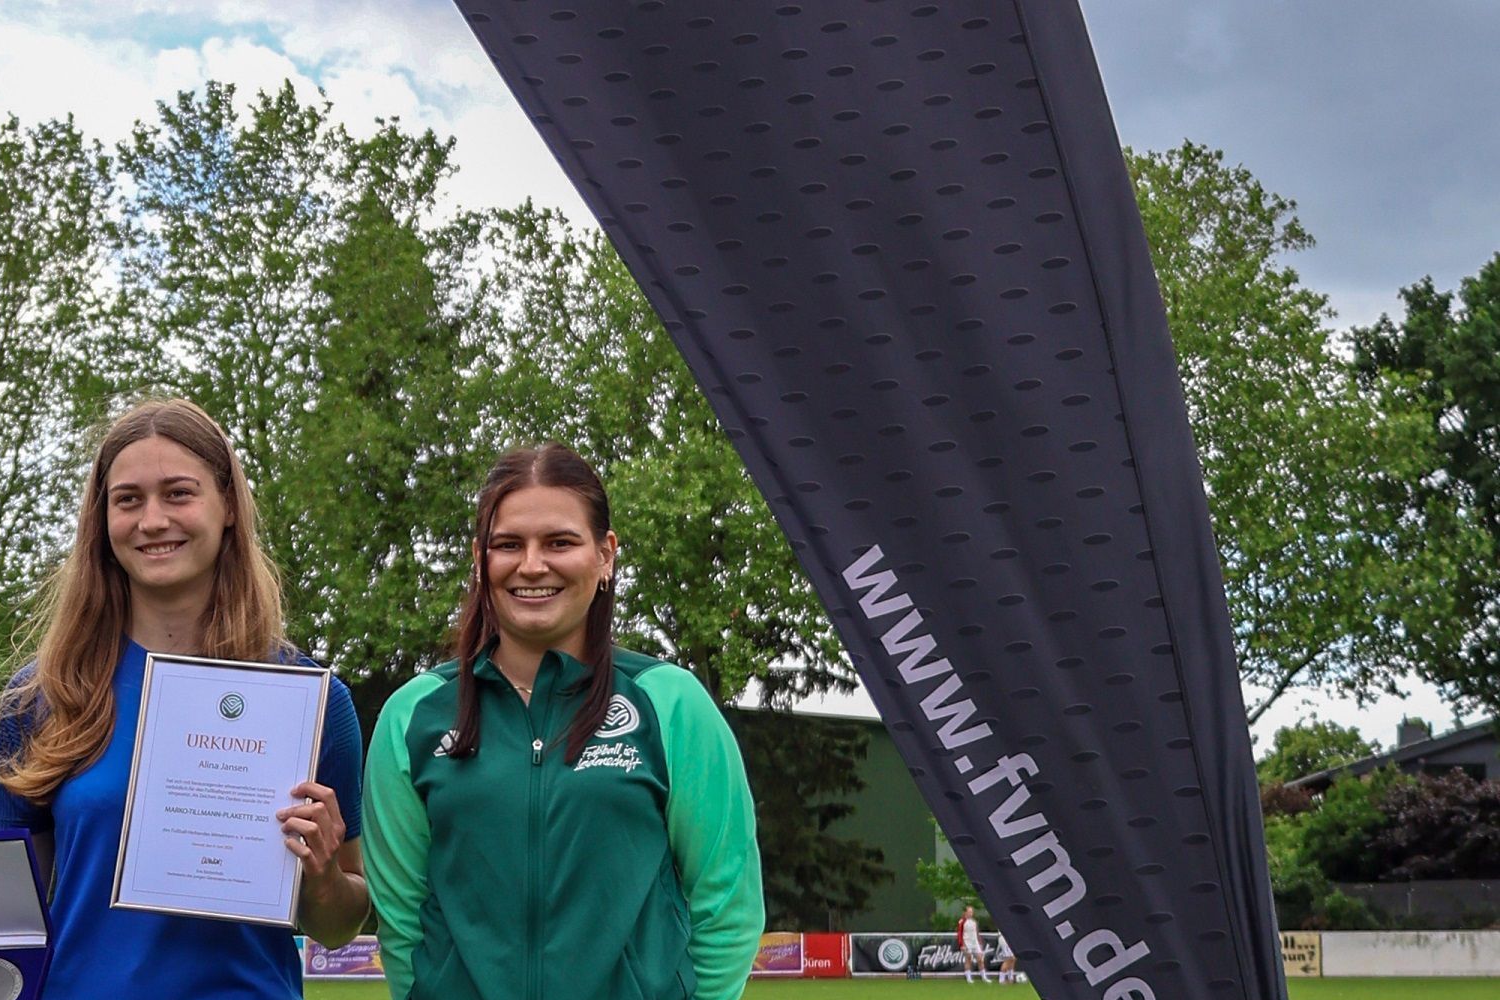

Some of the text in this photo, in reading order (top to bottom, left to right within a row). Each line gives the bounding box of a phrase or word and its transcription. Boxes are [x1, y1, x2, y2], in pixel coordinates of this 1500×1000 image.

[187, 733, 267, 755] URKUNDE
[623, 744, 639, 757] ist
[199, 760, 248, 773] Alina Jansen
[164, 806, 253, 821] MARKO-TILLMANN-PLAKETTE
